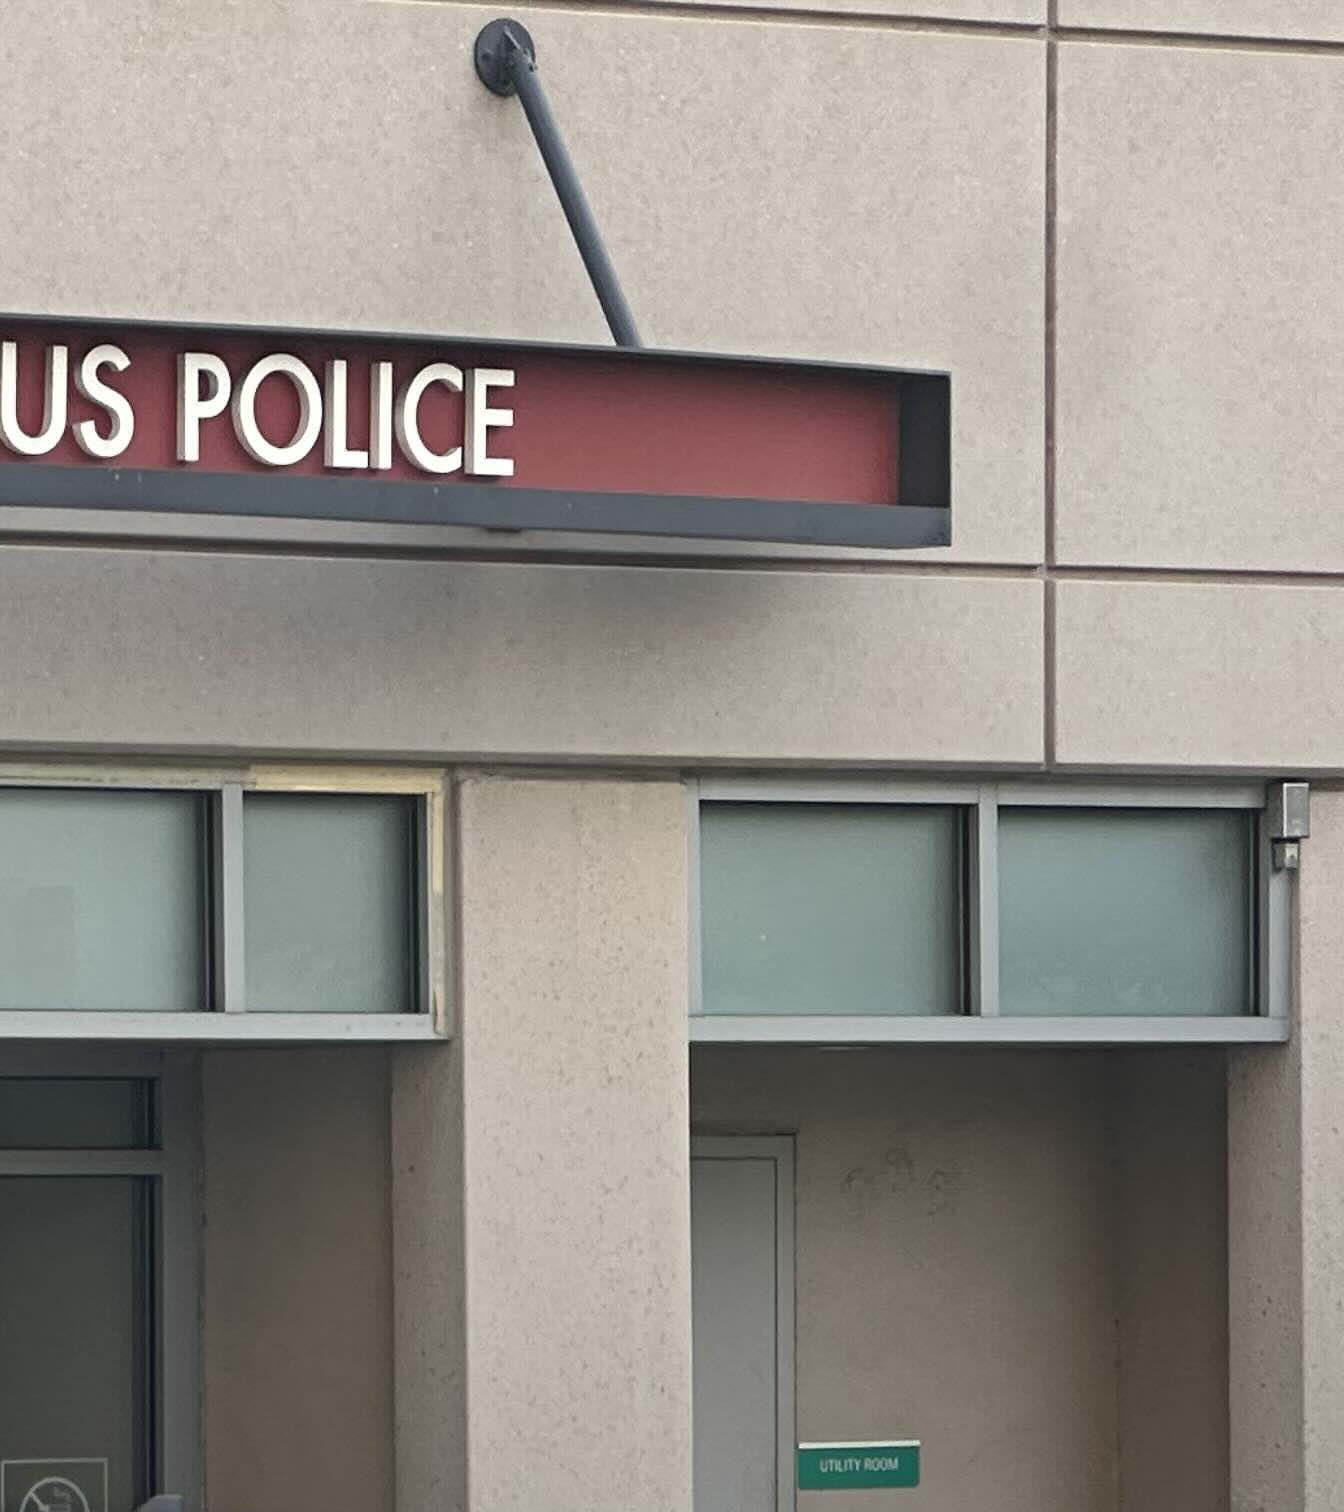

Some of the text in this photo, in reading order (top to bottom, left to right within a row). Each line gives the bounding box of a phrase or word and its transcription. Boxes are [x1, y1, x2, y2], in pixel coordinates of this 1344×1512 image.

[176, 351, 515, 477] POLICE
[820, 1457, 899, 1472] UTILITY ROOM
